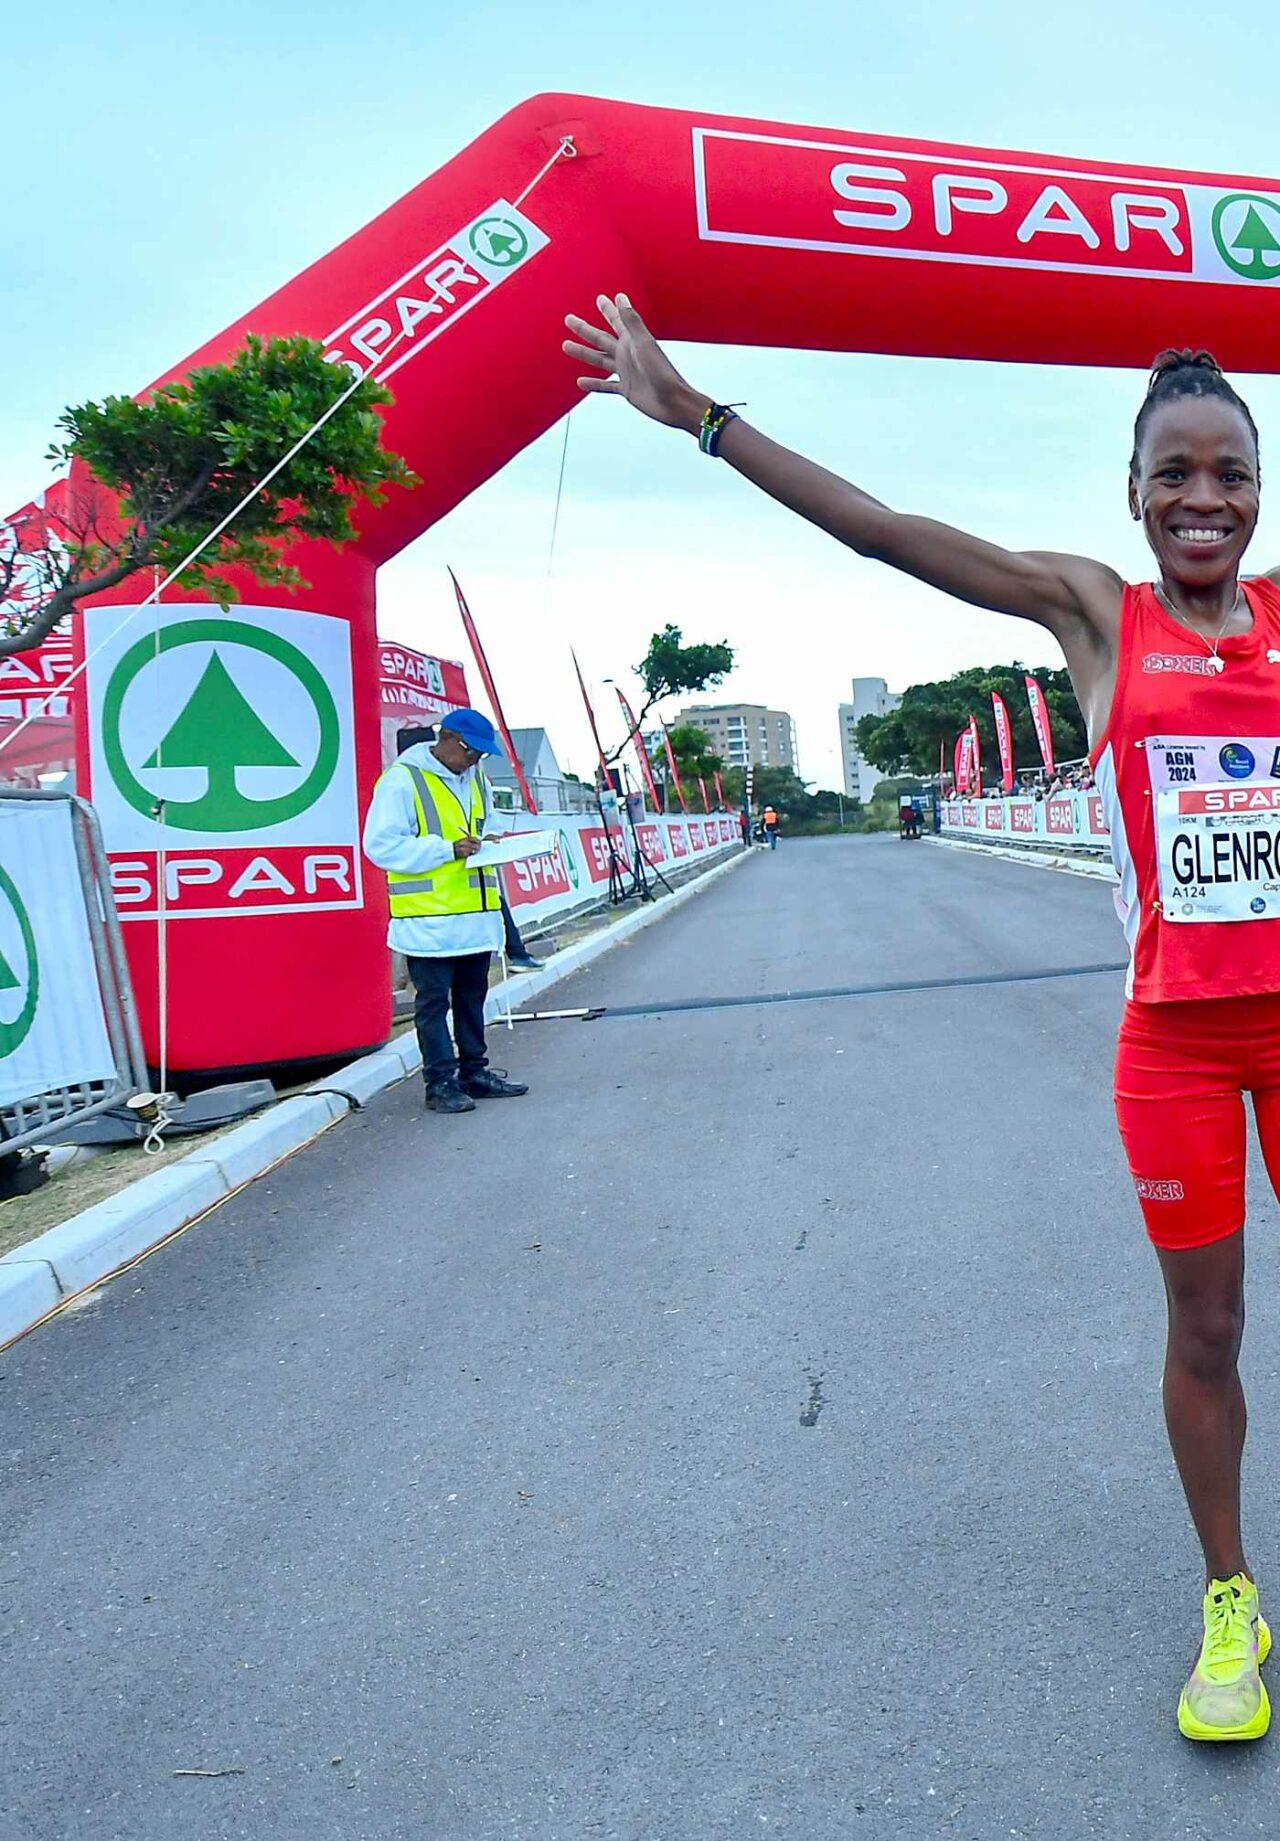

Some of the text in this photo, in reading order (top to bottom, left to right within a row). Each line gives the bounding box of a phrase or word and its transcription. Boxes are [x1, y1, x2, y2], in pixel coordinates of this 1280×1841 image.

[829, 162, 1185, 257] SPAR
[380, 652, 428, 684] SPAR
[1166, 752, 1194, 766] AGN
[1168, 767, 1197, 782] 2024
[1050, 796, 1073, 829] SPAR
[1178, 817, 1197, 825] 10KM
[109, 854, 351, 904] SPAR
[1172, 886, 1206, 898] A124
